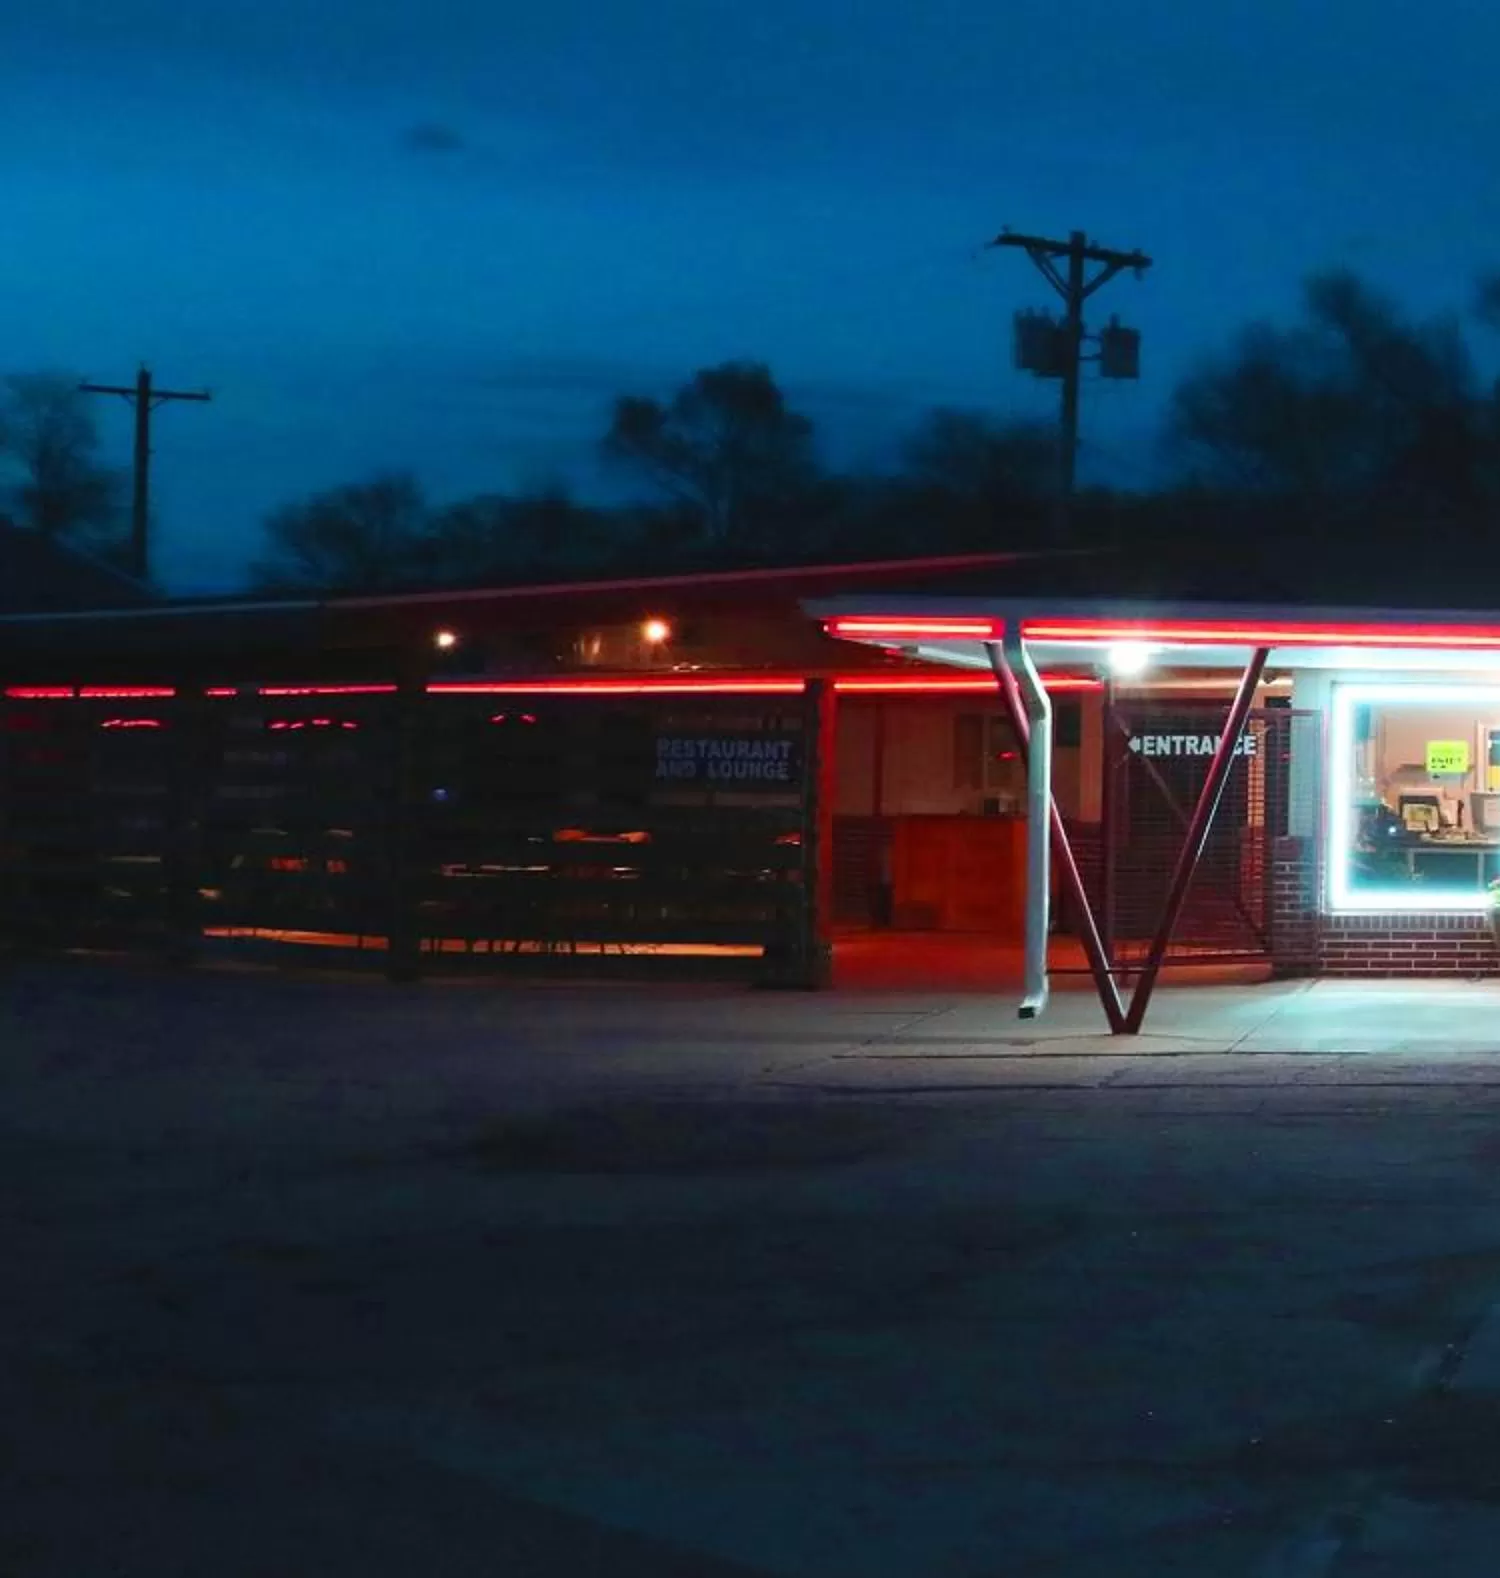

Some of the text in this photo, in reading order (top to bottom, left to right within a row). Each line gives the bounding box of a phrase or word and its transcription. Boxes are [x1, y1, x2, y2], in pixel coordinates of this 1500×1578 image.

[656, 738, 793, 759] RESTAURANT
[656, 760, 790, 779] AND LOUNGE
